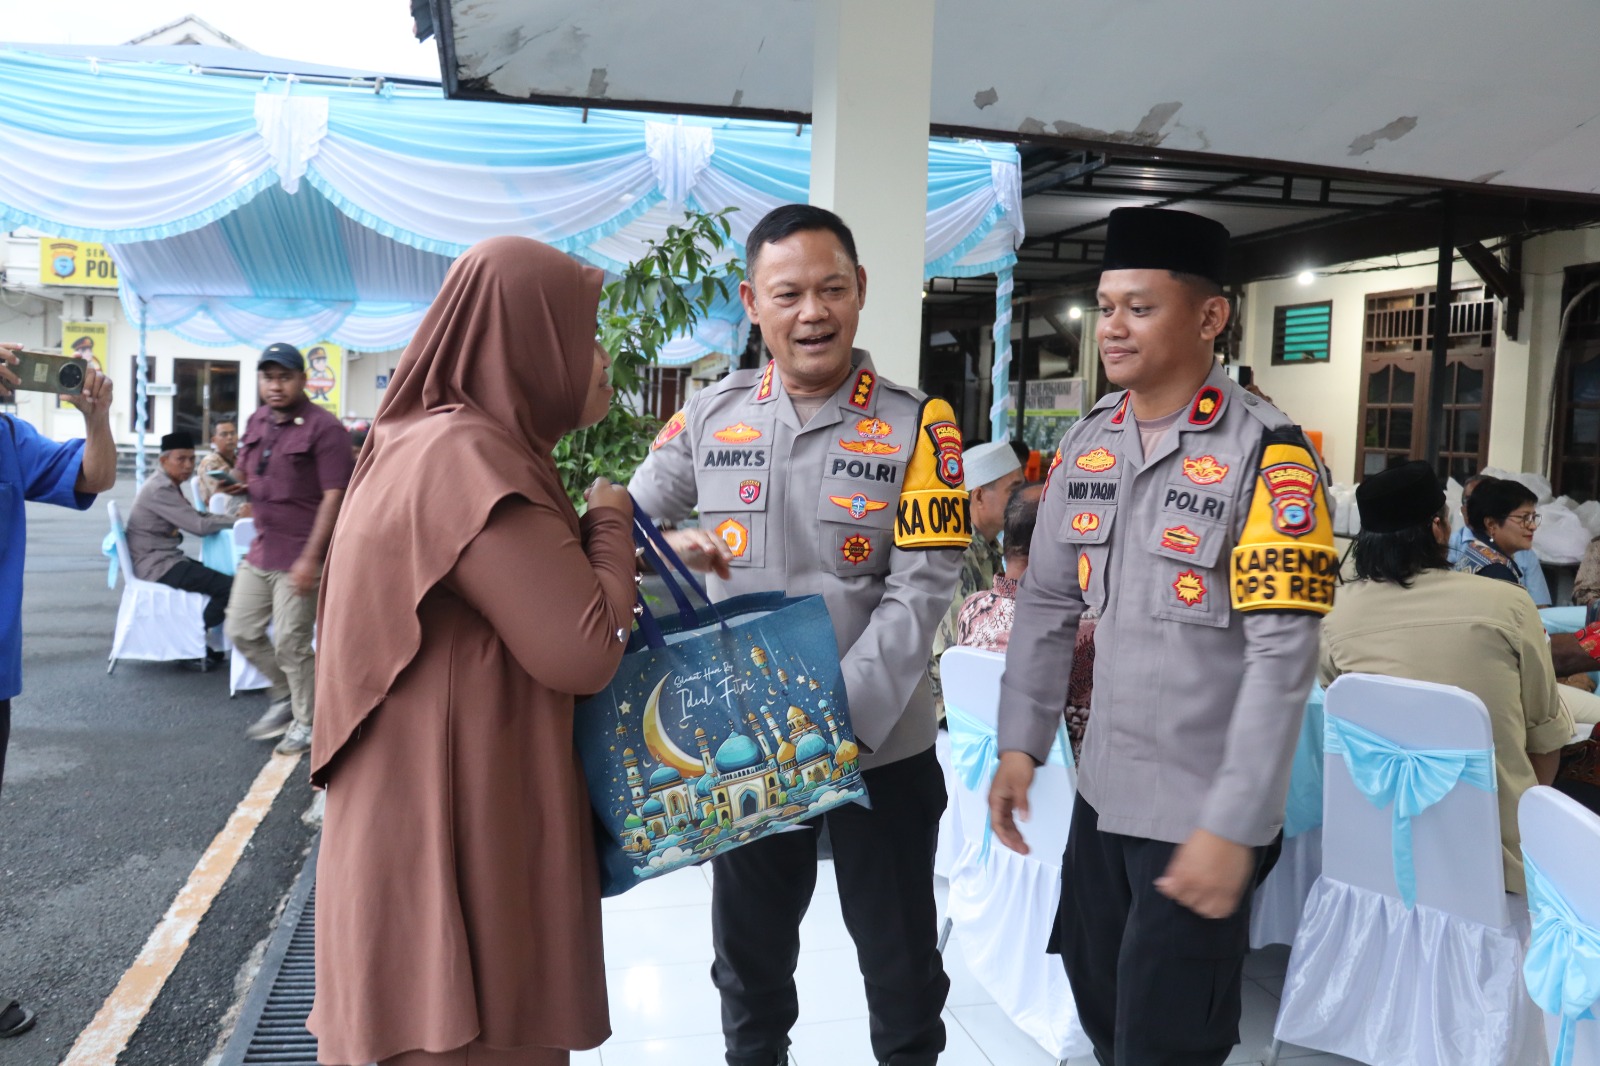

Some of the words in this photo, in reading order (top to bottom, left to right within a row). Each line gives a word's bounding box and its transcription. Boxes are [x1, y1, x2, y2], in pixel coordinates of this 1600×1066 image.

[86, 248, 110, 258] SEN
[704, 450, 765, 467] AMRY.S
[832, 458, 896, 483] POLRI
[1068, 482, 1088, 499] ANDI
[1090, 482, 1117, 501] YAQIN
[1165, 489, 1225, 520] POLRI
[897, 499, 925, 537] KA
[928, 497, 961, 533] OPS
[1236, 575, 1276, 603] OPS
[716, 675, 755, 709] Fitri
